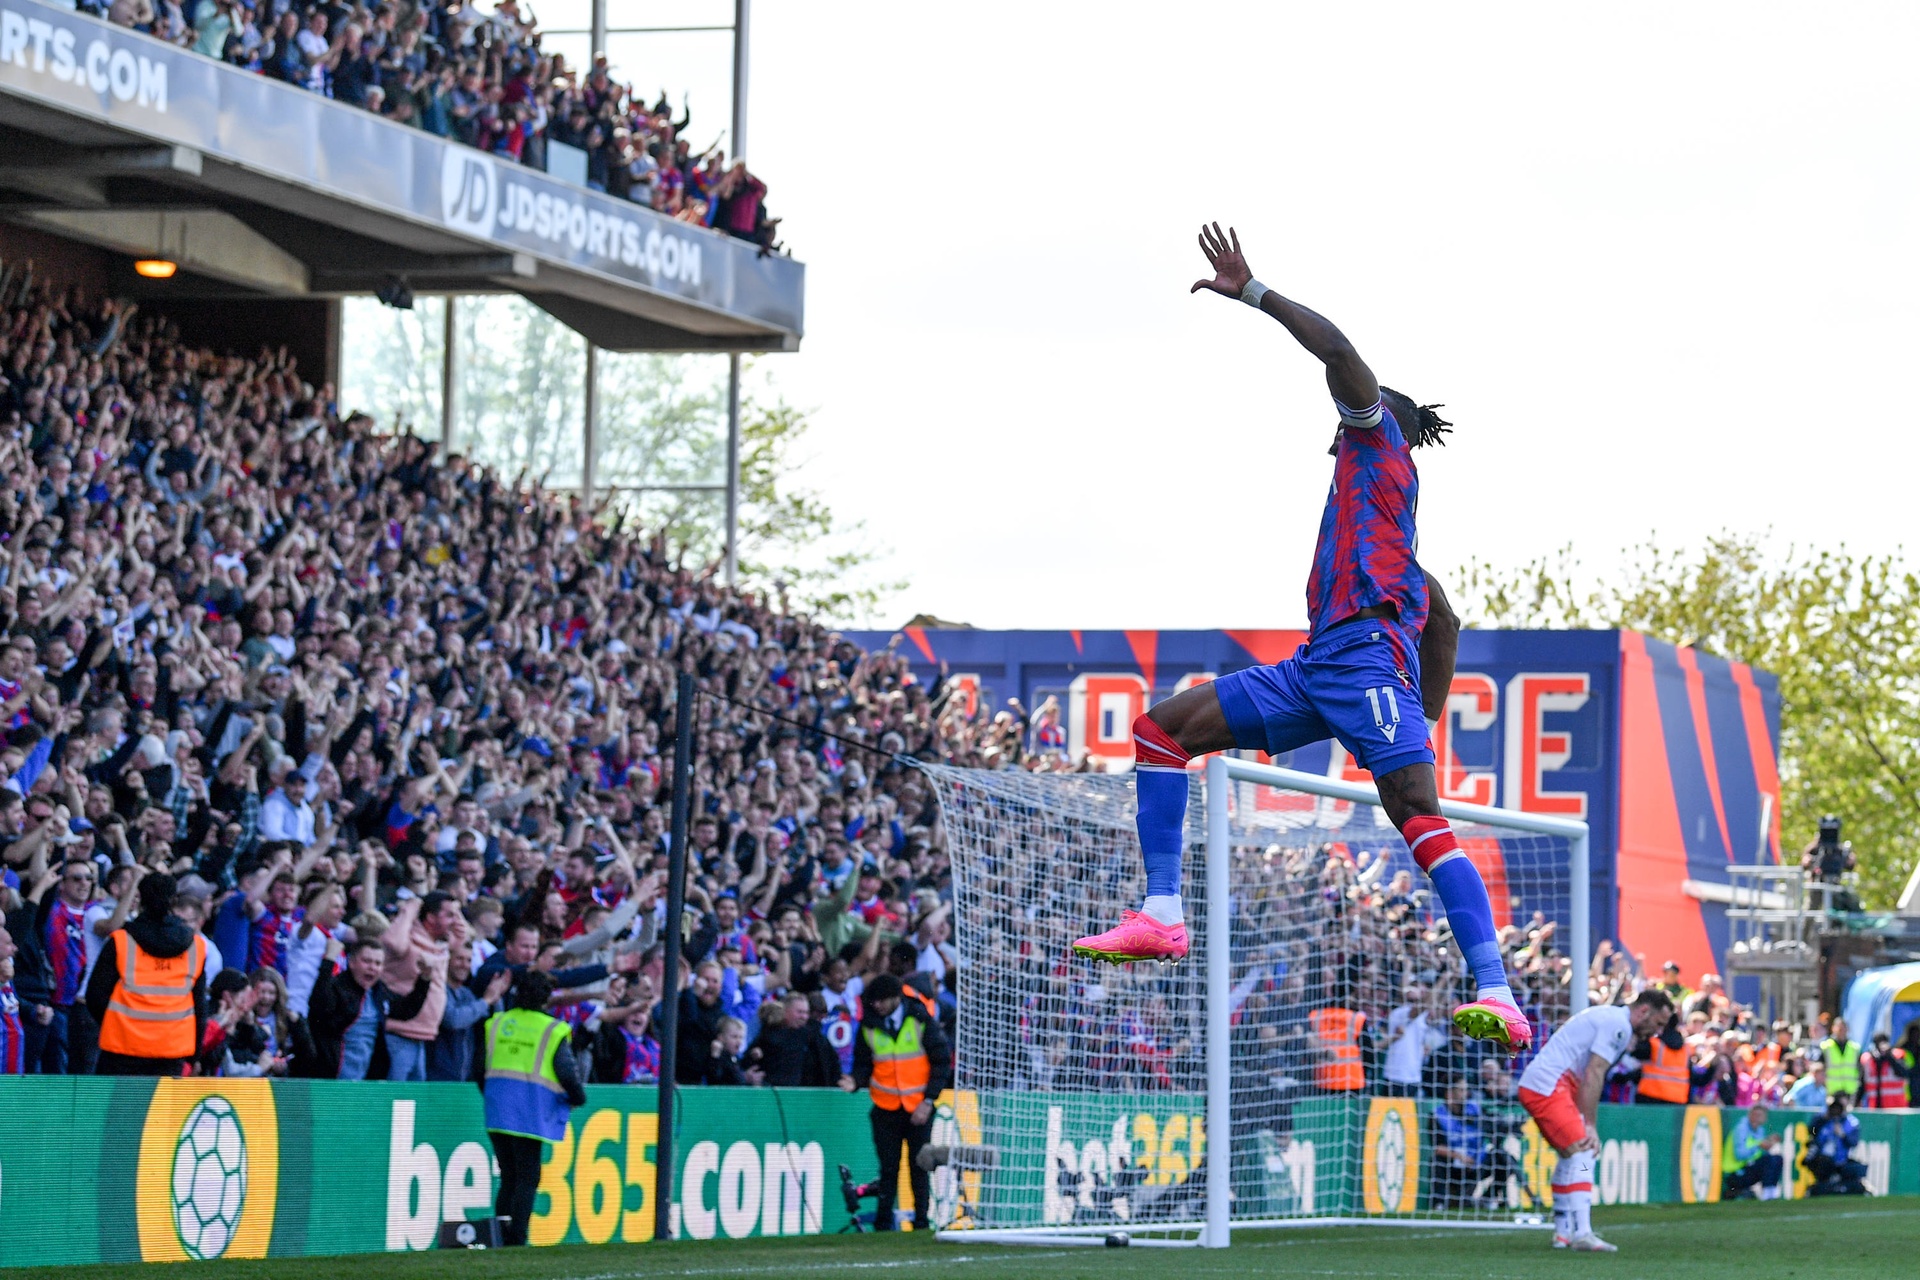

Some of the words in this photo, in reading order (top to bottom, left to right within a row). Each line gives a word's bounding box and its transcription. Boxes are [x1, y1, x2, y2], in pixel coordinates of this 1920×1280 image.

[1, 9, 168, 113] RTS.COM
[498, 182, 701, 286] JDSPORTS.COM
[1068, 671, 1591, 828] PLCE
[1365, 686, 1401, 727] 11
[385, 1099, 825, 1251] be365.com
[1043, 1105, 1316, 1224] bet36m
